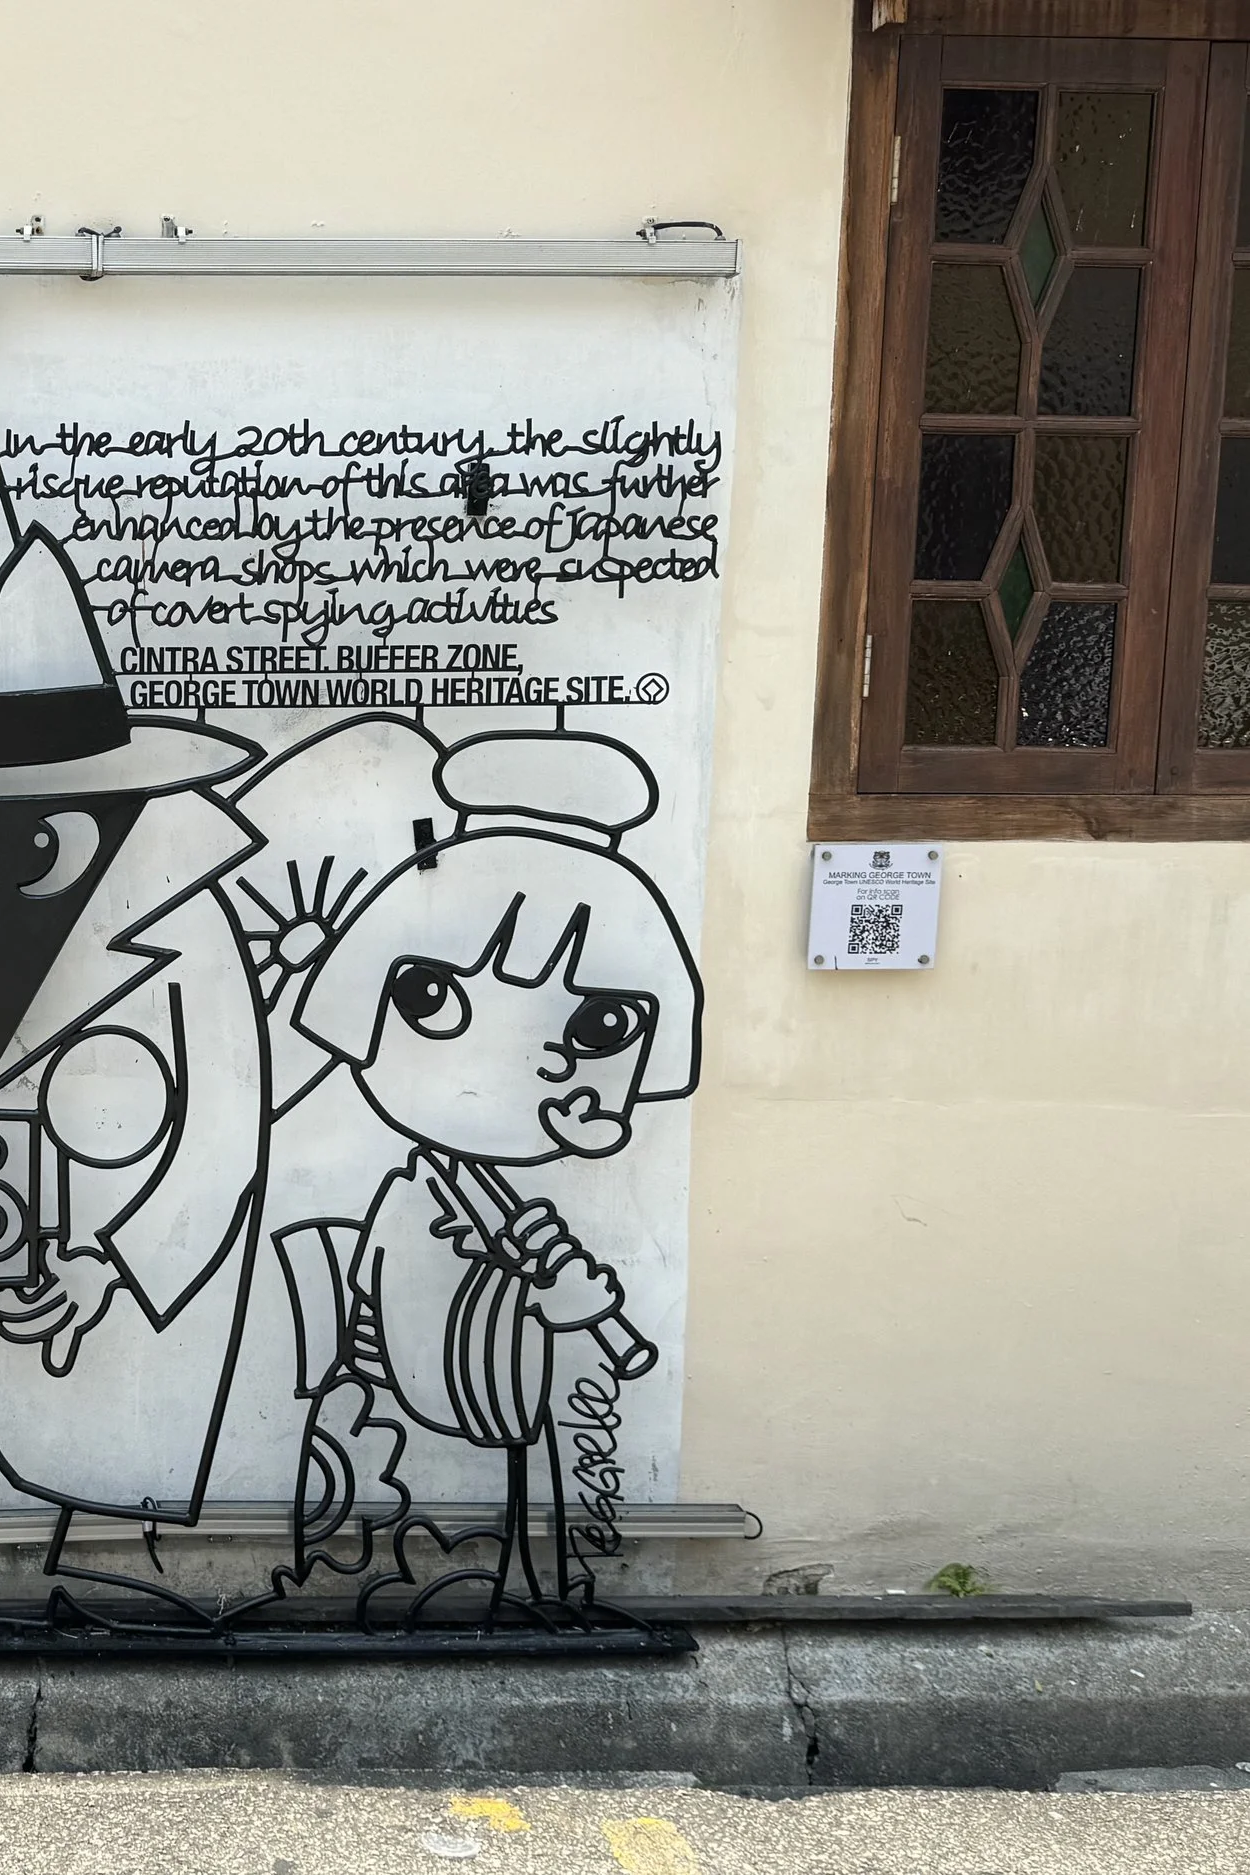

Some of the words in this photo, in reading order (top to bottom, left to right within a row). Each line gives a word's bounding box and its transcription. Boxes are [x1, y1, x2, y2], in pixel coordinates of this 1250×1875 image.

[6, 429, 39, 457] In
[56, 422, 111, 457] the
[129, 420, 217, 475] early
[238, 419, 325, 456] 20th
[507, 418, 563, 456] the
[582, 415, 721, 472] slightly
[15, 463, 124, 513] risque
[136, 461, 303, 512] reputation
[321, 461, 361, 516] of
[365, 459, 429, 498] this
[440, 471, 510, 499] area
[519, 471, 588, 498] was
[602, 462, 720, 514] further
[73, 505, 244, 541] enhanced
[251, 504, 302, 560] by
[305, 507, 365, 540] the
[372, 515, 514, 555] presence
[525, 502, 566, 553] of
[556, 506, 719, 556] Japanese
[97, 555, 220, 587] camera
[241, 549, 332, 598] shops
[350, 545, 448, 585] which
[465, 556, 541, 582] were
[556, 548, 720, 598] suspected
[108, 589, 148, 648] of
[151, 592, 254, 627] covert
[264, 588, 394, 646] spying
[407, 586, 559, 625] activities
[120, 646, 218, 673] CINTRA
[337, 644, 439, 672] BUFFER
[446, 643, 523, 676] ZONE,
[130, 680, 236, 706] GEORGE
[242, 679, 319, 706] TOWN
[326, 678, 424, 705] WORLD
[431, 676, 560, 704] HERITAGE
[828, 871, 867, 879] MARKING
[868, 871, 904, 879] GEORGE
[906, 871, 932, 879] TOWN
